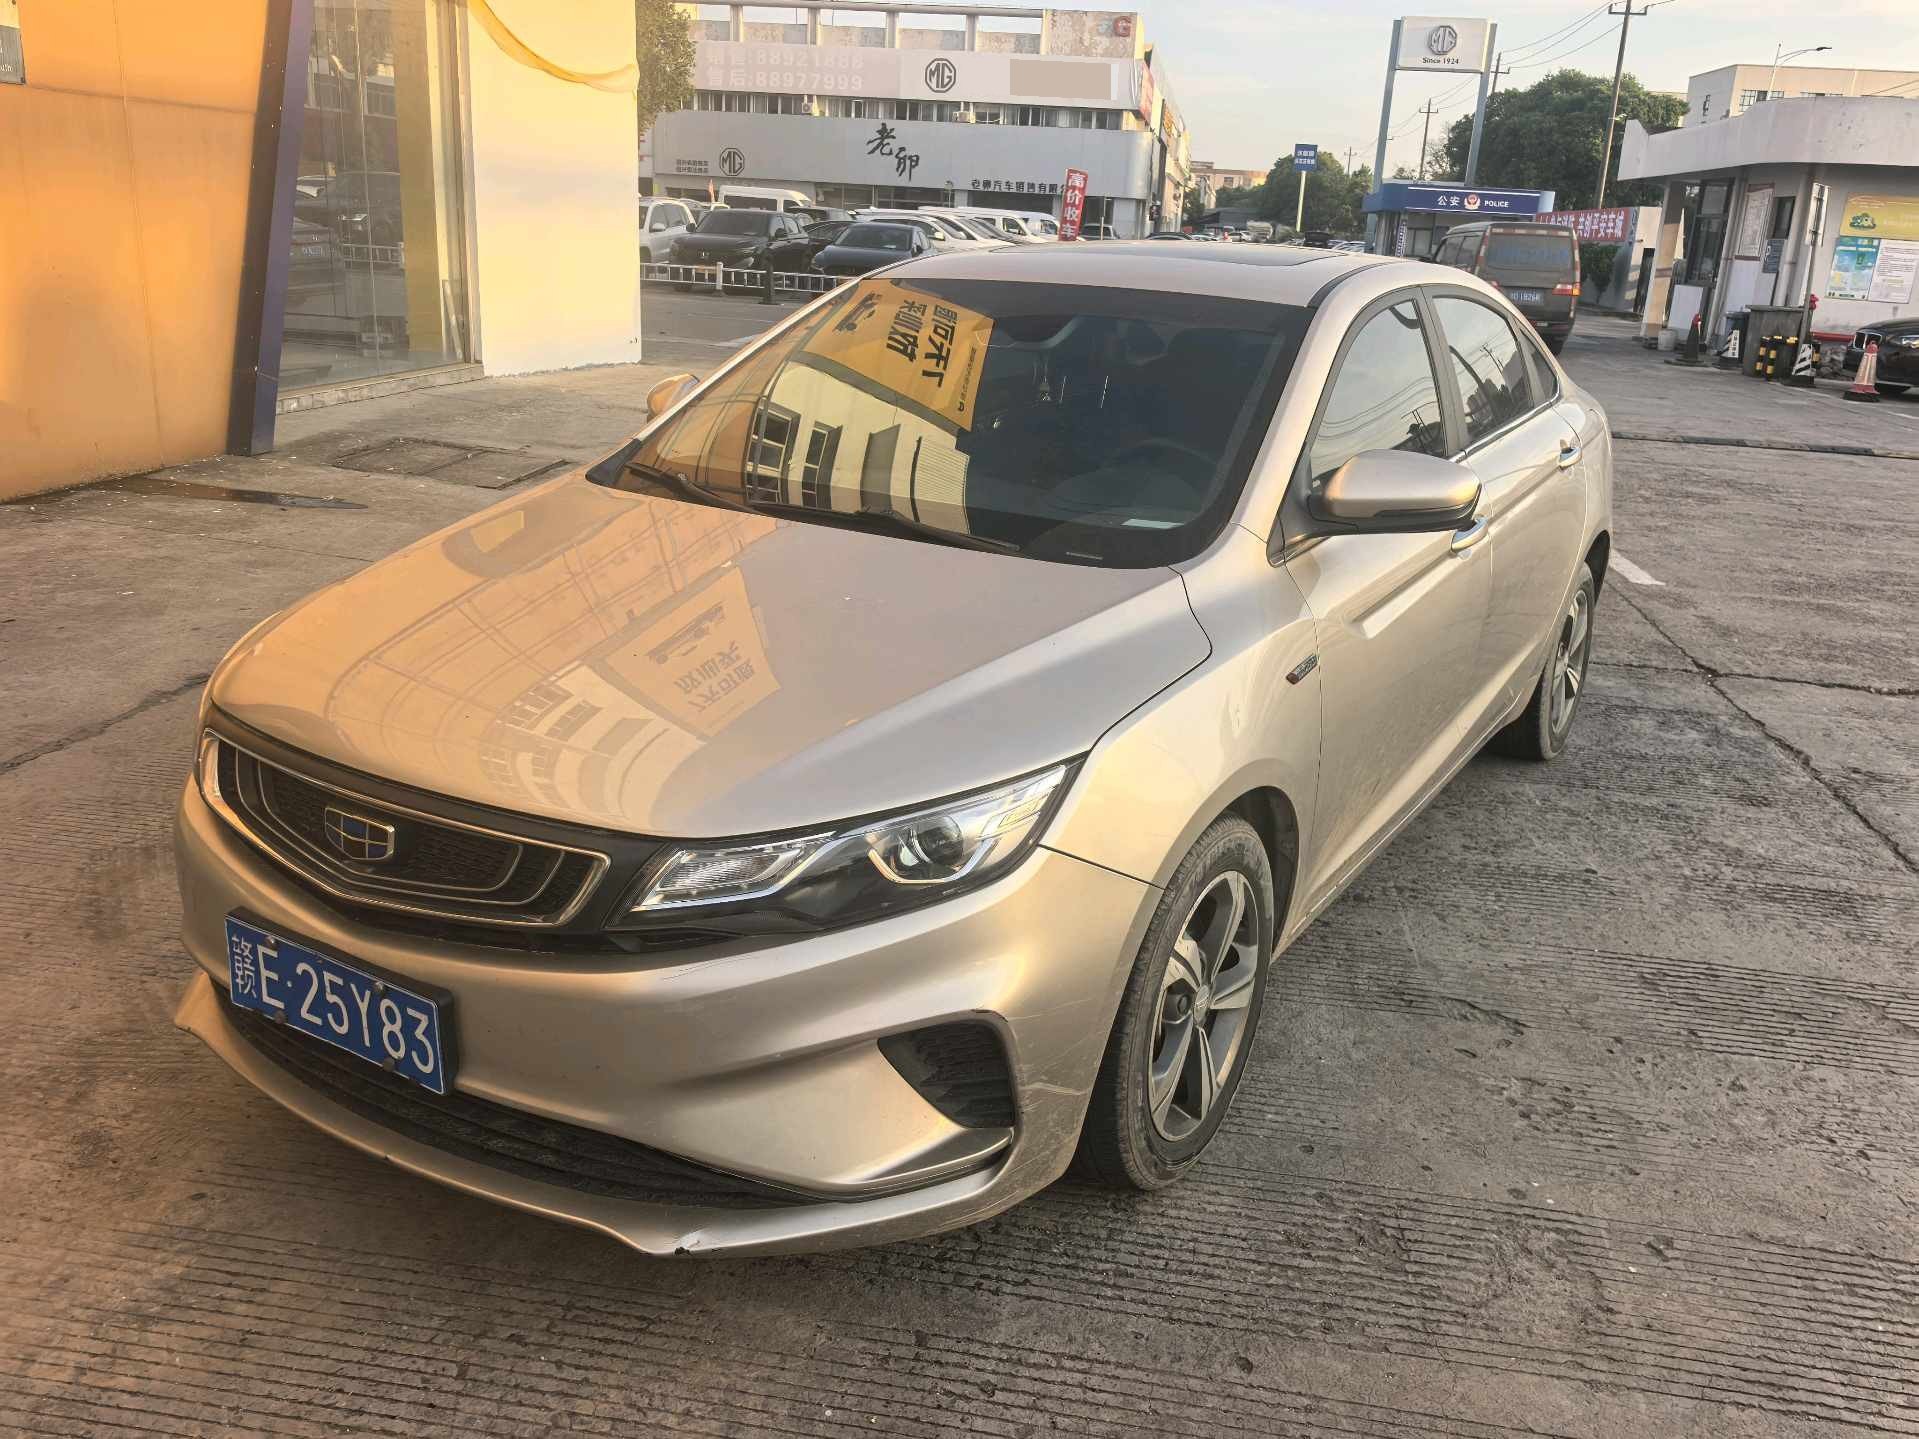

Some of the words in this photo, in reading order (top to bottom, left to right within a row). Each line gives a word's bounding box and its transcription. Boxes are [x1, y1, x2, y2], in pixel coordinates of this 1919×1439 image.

[926, 59, 955, 91] MG
[720, 148, 744, 175] MG
[1061, 172, 1086, 239] 高价收车
[1437, 195, 1461, 206] 公安
[1484, 200, 1510, 208] POLICE
[231, 934, 434, 1074] 赣E·25Y83
